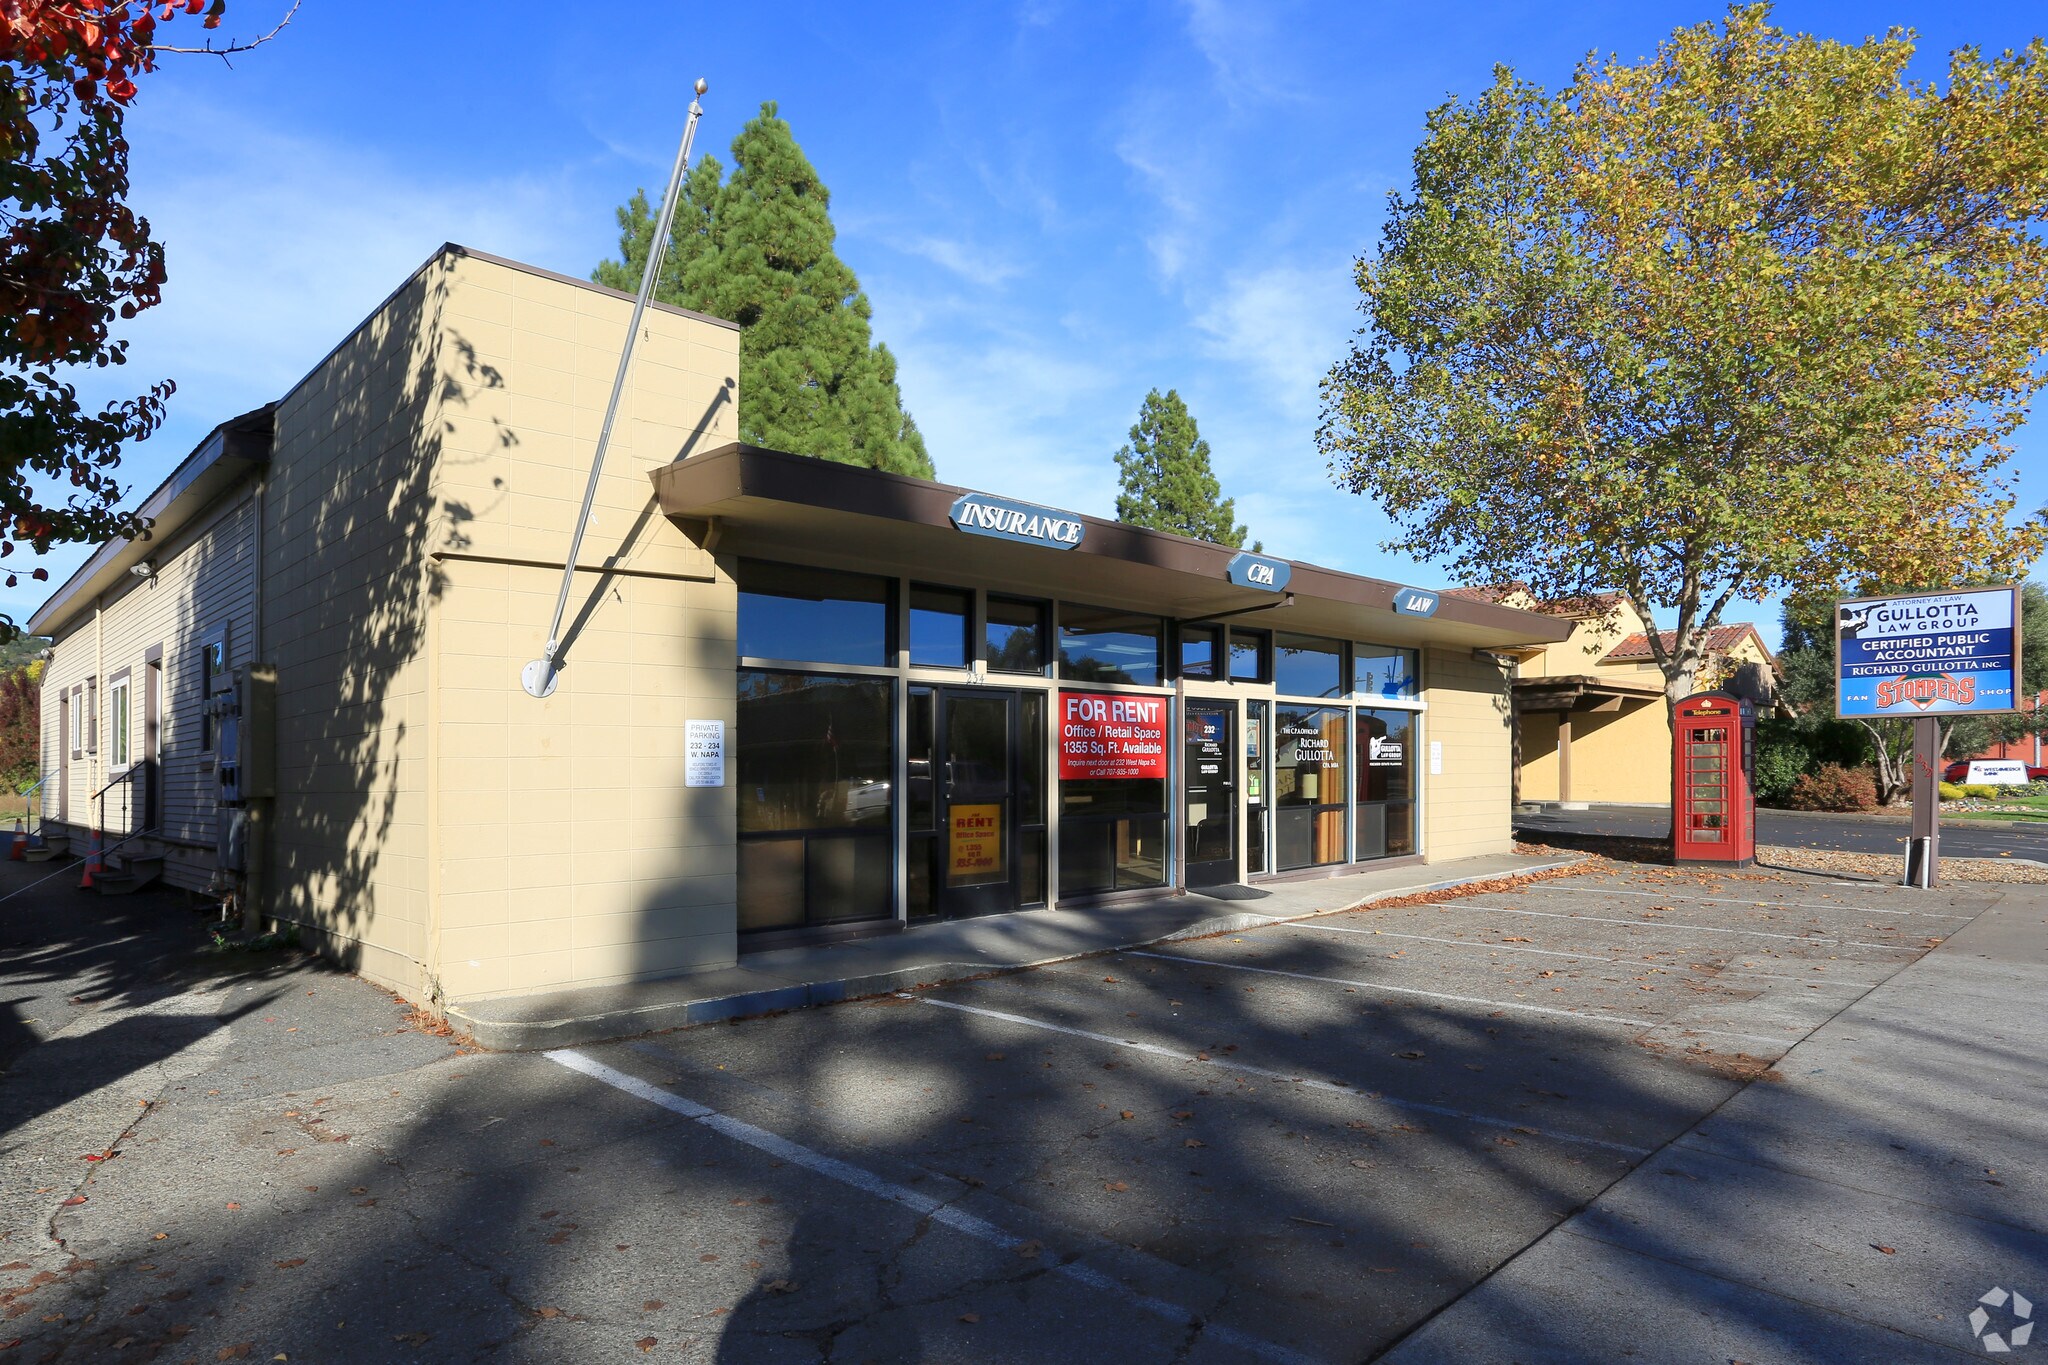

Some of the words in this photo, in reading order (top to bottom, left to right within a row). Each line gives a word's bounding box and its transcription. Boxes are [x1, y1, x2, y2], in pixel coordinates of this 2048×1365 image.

[959, 502, 1081, 544] INSURANCE
[1247, 563, 1275, 586] CPA
[1406, 594, 1433, 612] LAW
[1892, 598, 1932, 607] ATTORNEY
[1876, 603, 1978, 622] GULLOTTA
[1878, 623, 1911, 633] LAW
[1917, 618, 1979, 630] GROUP
[1862, 637, 1933, 651] CERTIFIED
[1937, 633, 1990, 646] PUBLIC
[1874, 646, 1976, 661] ACCOUNTANT
[1852, 664, 1909, 676] RICHARD
[1911, 661, 1978, 673] GULLOTTA
[1982, 661, 2001, 669] INC.
[1876, 676, 1976, 709] STOMPERS
[1067, 698, 1107, 721] FOR
[1112, 701, 1159, 723] RENT
[1692, 709, 1721, 717] Telephone
[1064, 724, 1096, 738] Office
[1105, 726, 1132, 738] Retail
[1134, 726, 1161, 741] Space
[1203, 725, 1215, 734] 232
[1064, 741, 1088, 754] 1355
[1090, 741, 1106, 756] Sq.
[1108, 742, 1120, 754] Ft.
[1122, 742, 1161, 754] Available
[1300, 737, 1329, 748] RICHARD
[1294, 749, 1334, 761] GULLOTTA
[1067, 759, 1085, 767] Inquire
[1138, 759, 1149, 767] Napa
[1916, 753, 1933, 778] 232
[956, 817, 994, 828] RENT
